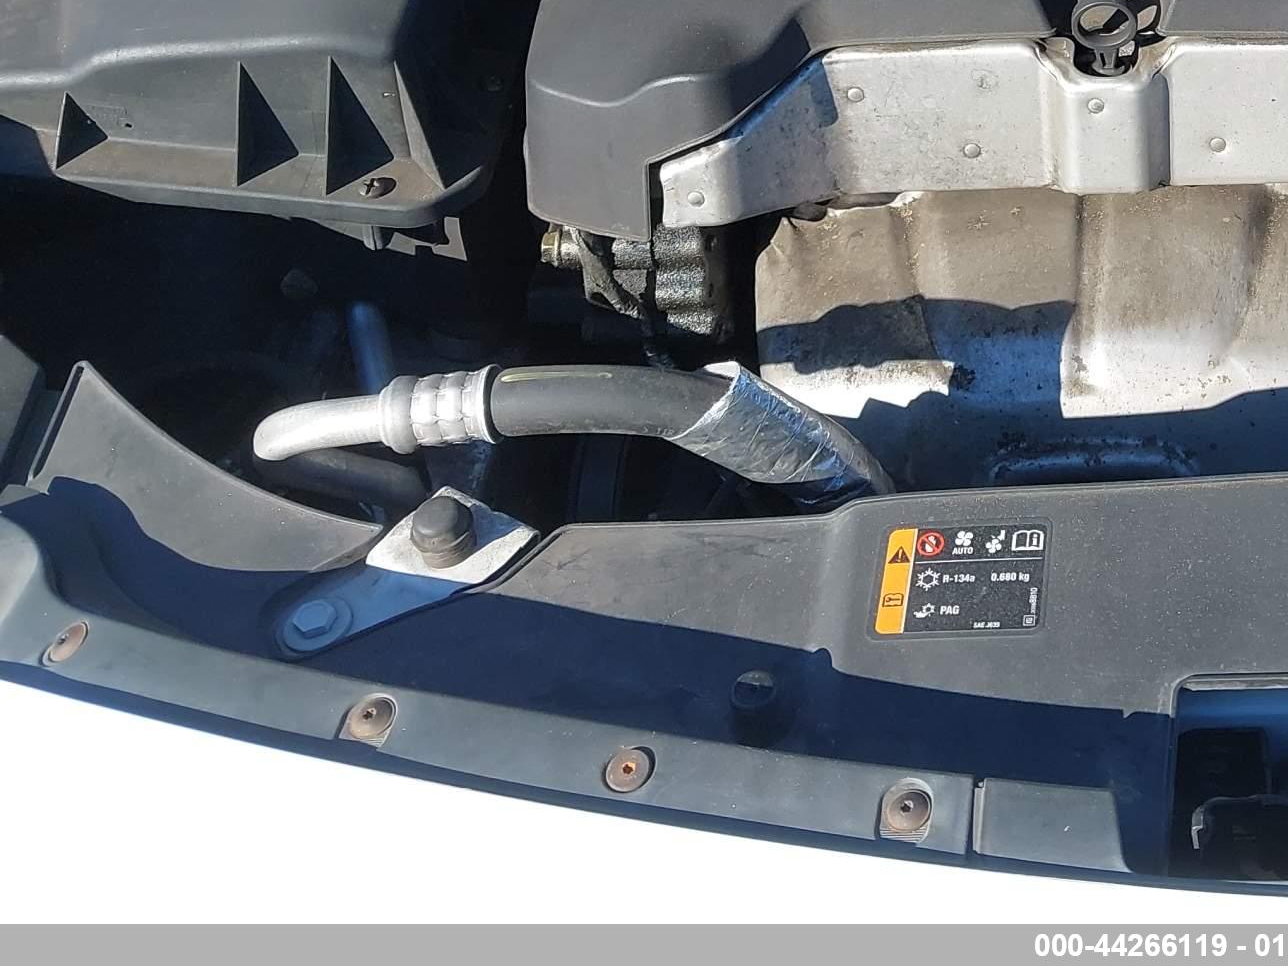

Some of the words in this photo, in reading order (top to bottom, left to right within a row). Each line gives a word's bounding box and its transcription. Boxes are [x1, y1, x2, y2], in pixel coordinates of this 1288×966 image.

[952, 547, 974, 555] AUTO
[942, 574, 976, 583] R-134a
[990, 572, 1017, 582] 0.680
[1018, 572, 1030, 583] kg
[940, 605, 960, 615] PAG
